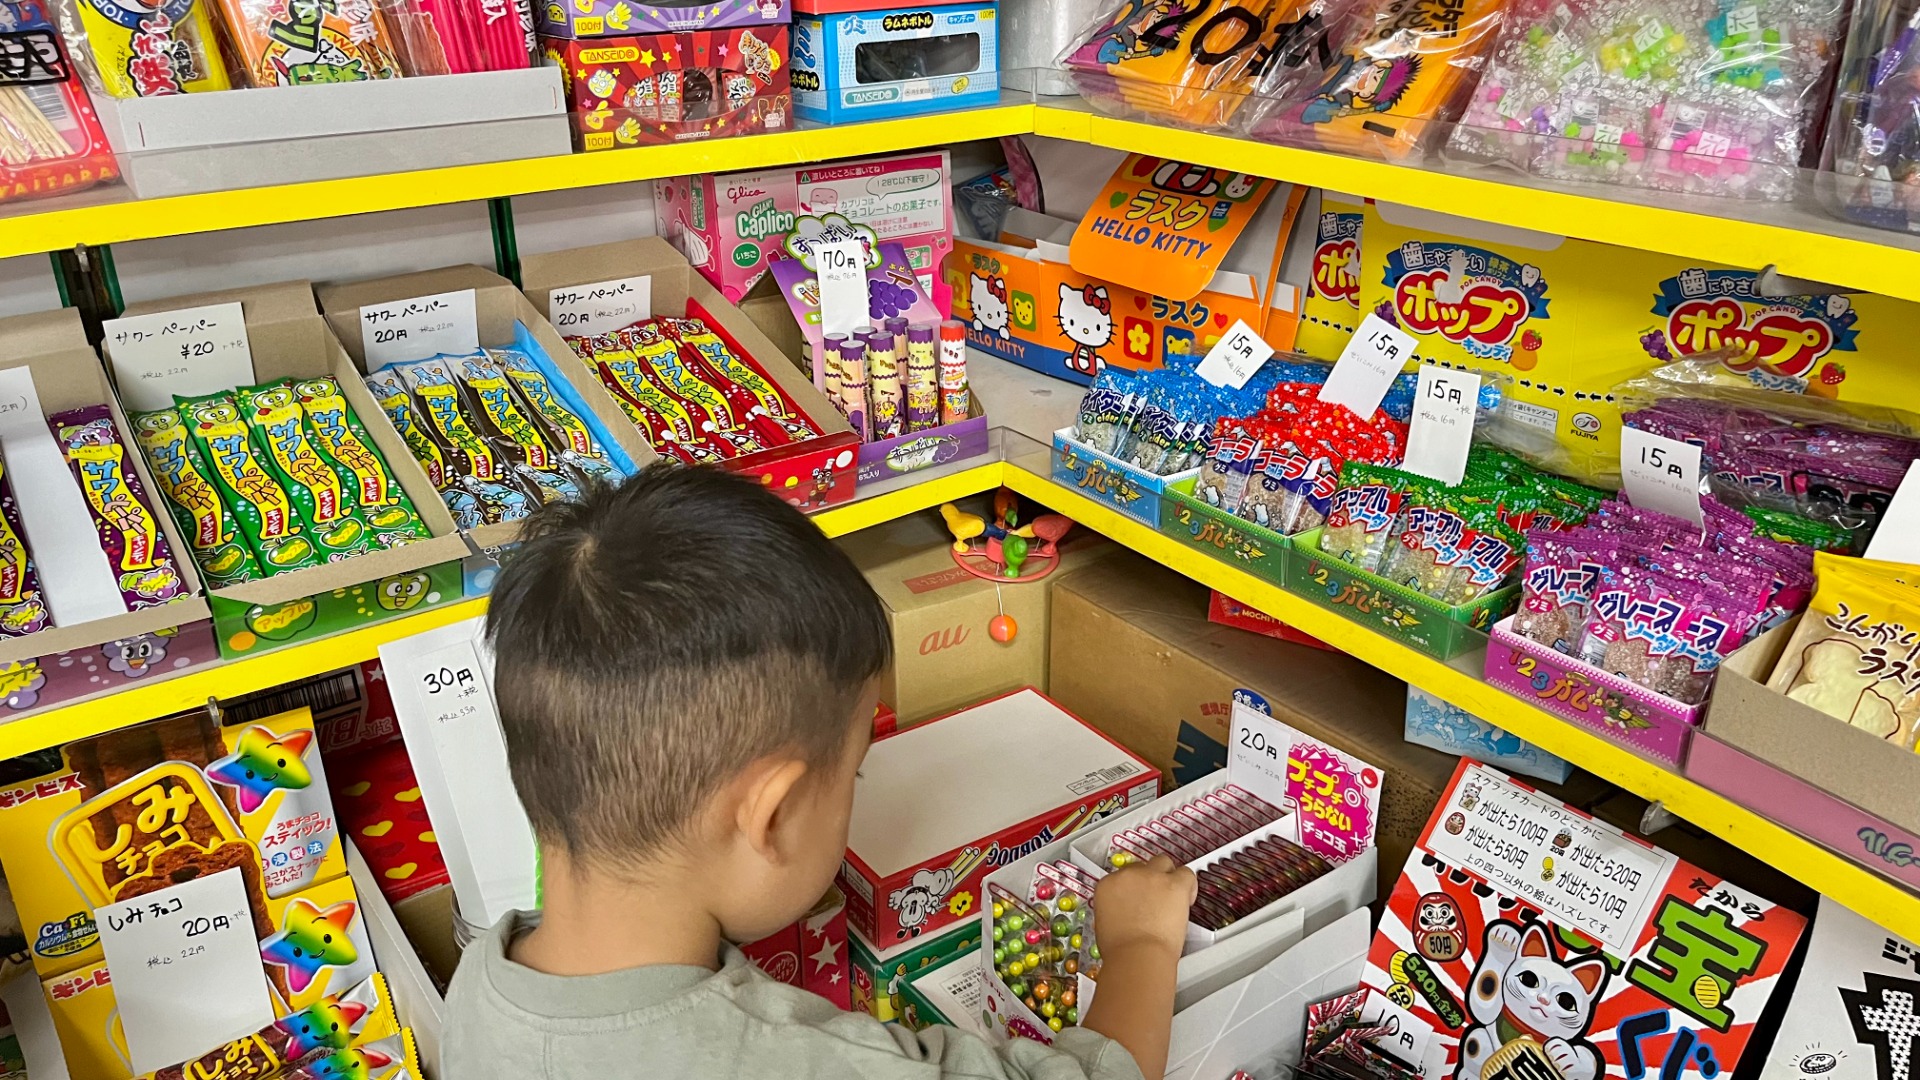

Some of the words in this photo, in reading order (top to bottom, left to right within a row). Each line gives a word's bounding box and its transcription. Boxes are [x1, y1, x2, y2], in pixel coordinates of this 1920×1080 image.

[843, 15, 867, 35] グミ
[883, 13, 934, 31] ラムネボトル
[727, 186, 766, 204] Glico
[752, 198, 774, 218] GIANT
[1127, 189, 1209, 232] ラスク
[738, 210, 794, 241] Caplico
[1091, 217, 1151, 246] HELLO
[1151, 231, 1213, 261] KITTY
[735, 250, 757, 260] いちご
[823, 249, 856, 269] 70円
[971, 252, 1001, 275] ラスク
[554, 292, 585, 307] サワー
[588, 283, 634, 300] ペーパー
[1459, 277, 1475, 291] POP
[1475, 275, 1503, 287] CANDY
[364, 310, 397, 325] サワー
[402, 300, 449, 318] ペーパー
[559, 312, 590, 327] 20円
[1151, 297, 1209, 329] ラスク
[1750, 308, 1768, 321] POP
[1770, 304, 1804, 317] CANDY
[115, 331, 153, 346] サワー
[162, 319, 217, 336] ペーパー
[374, 328, 409, 344] 20円
[1368, 330, 1399, 360] 15円
[1676, 306, 1821, 365] ポップ
[181, 341, 214, 359] ¥20
[995, 338, 1026, 360] KITTY
[1227, 332, 1255, 361] 15円
[1462, 337, 1513, 362] キャンディ
[1427, 379, 1462, 404] 15円
[1097, 412, 1119, 423] cider
[1570, 429, 1599, 442] FUJIYA
[1206, 437, 1257, 461] コーラ
[1641, 446, 1683, 478] 15円
[1213, 463, 1227, 474] グミ
[1253, 450, 1312, 482] コーラ
[1262, 479, 1279, 491] グミ
[1335, 485, 1390, 513] アップル
[1328, 514, 1345, 527] グミ
[1408, 507, 1464, 548] アップル
[1402, 534, 1418, 549] グミ
[254, 599, 313, 632] アップル
[1527, 598, 1552, 613] グミ
[1597, 591, 1681, 634] グレープ
[918, 624, 972, 656] au
[1590, 623, 1617, 641] グミ
[423, 666, 475, 695] 30円
[1240, 727, 1278, 761] 20円
[1287, 757, 1345, 805] プチプチ
[1299, 792, 1352, 832] うらない
[1471, 772, 1604, 842] スクラッチカードのどこかに
[264, 817, 332, 848] スティック!
[1476, 799, 1550, 848] が出たら100円
[116, 828, 188, 873] チョコ
[1303, 820, 1348, 855] チョコ玉
[1464, 825, 1530, 870] が出たら50円
[1568, 843, 1643, 892] が出たら20円
[1555, 870, 1629, 921] が出たら10円
[1689, 876, 1768, 922] たから
[41, 923, 63, 937] Ca
[69, 913, 86, 928] Fi
[182, 914, 231, 938] 20円
[182, 944, 206, 960] 22円
[1427, 935, 1452, 956] 50円
[1630, 901, 1767, 1031] 宝
[1405, 956, 1463, 1028] 540円金券
